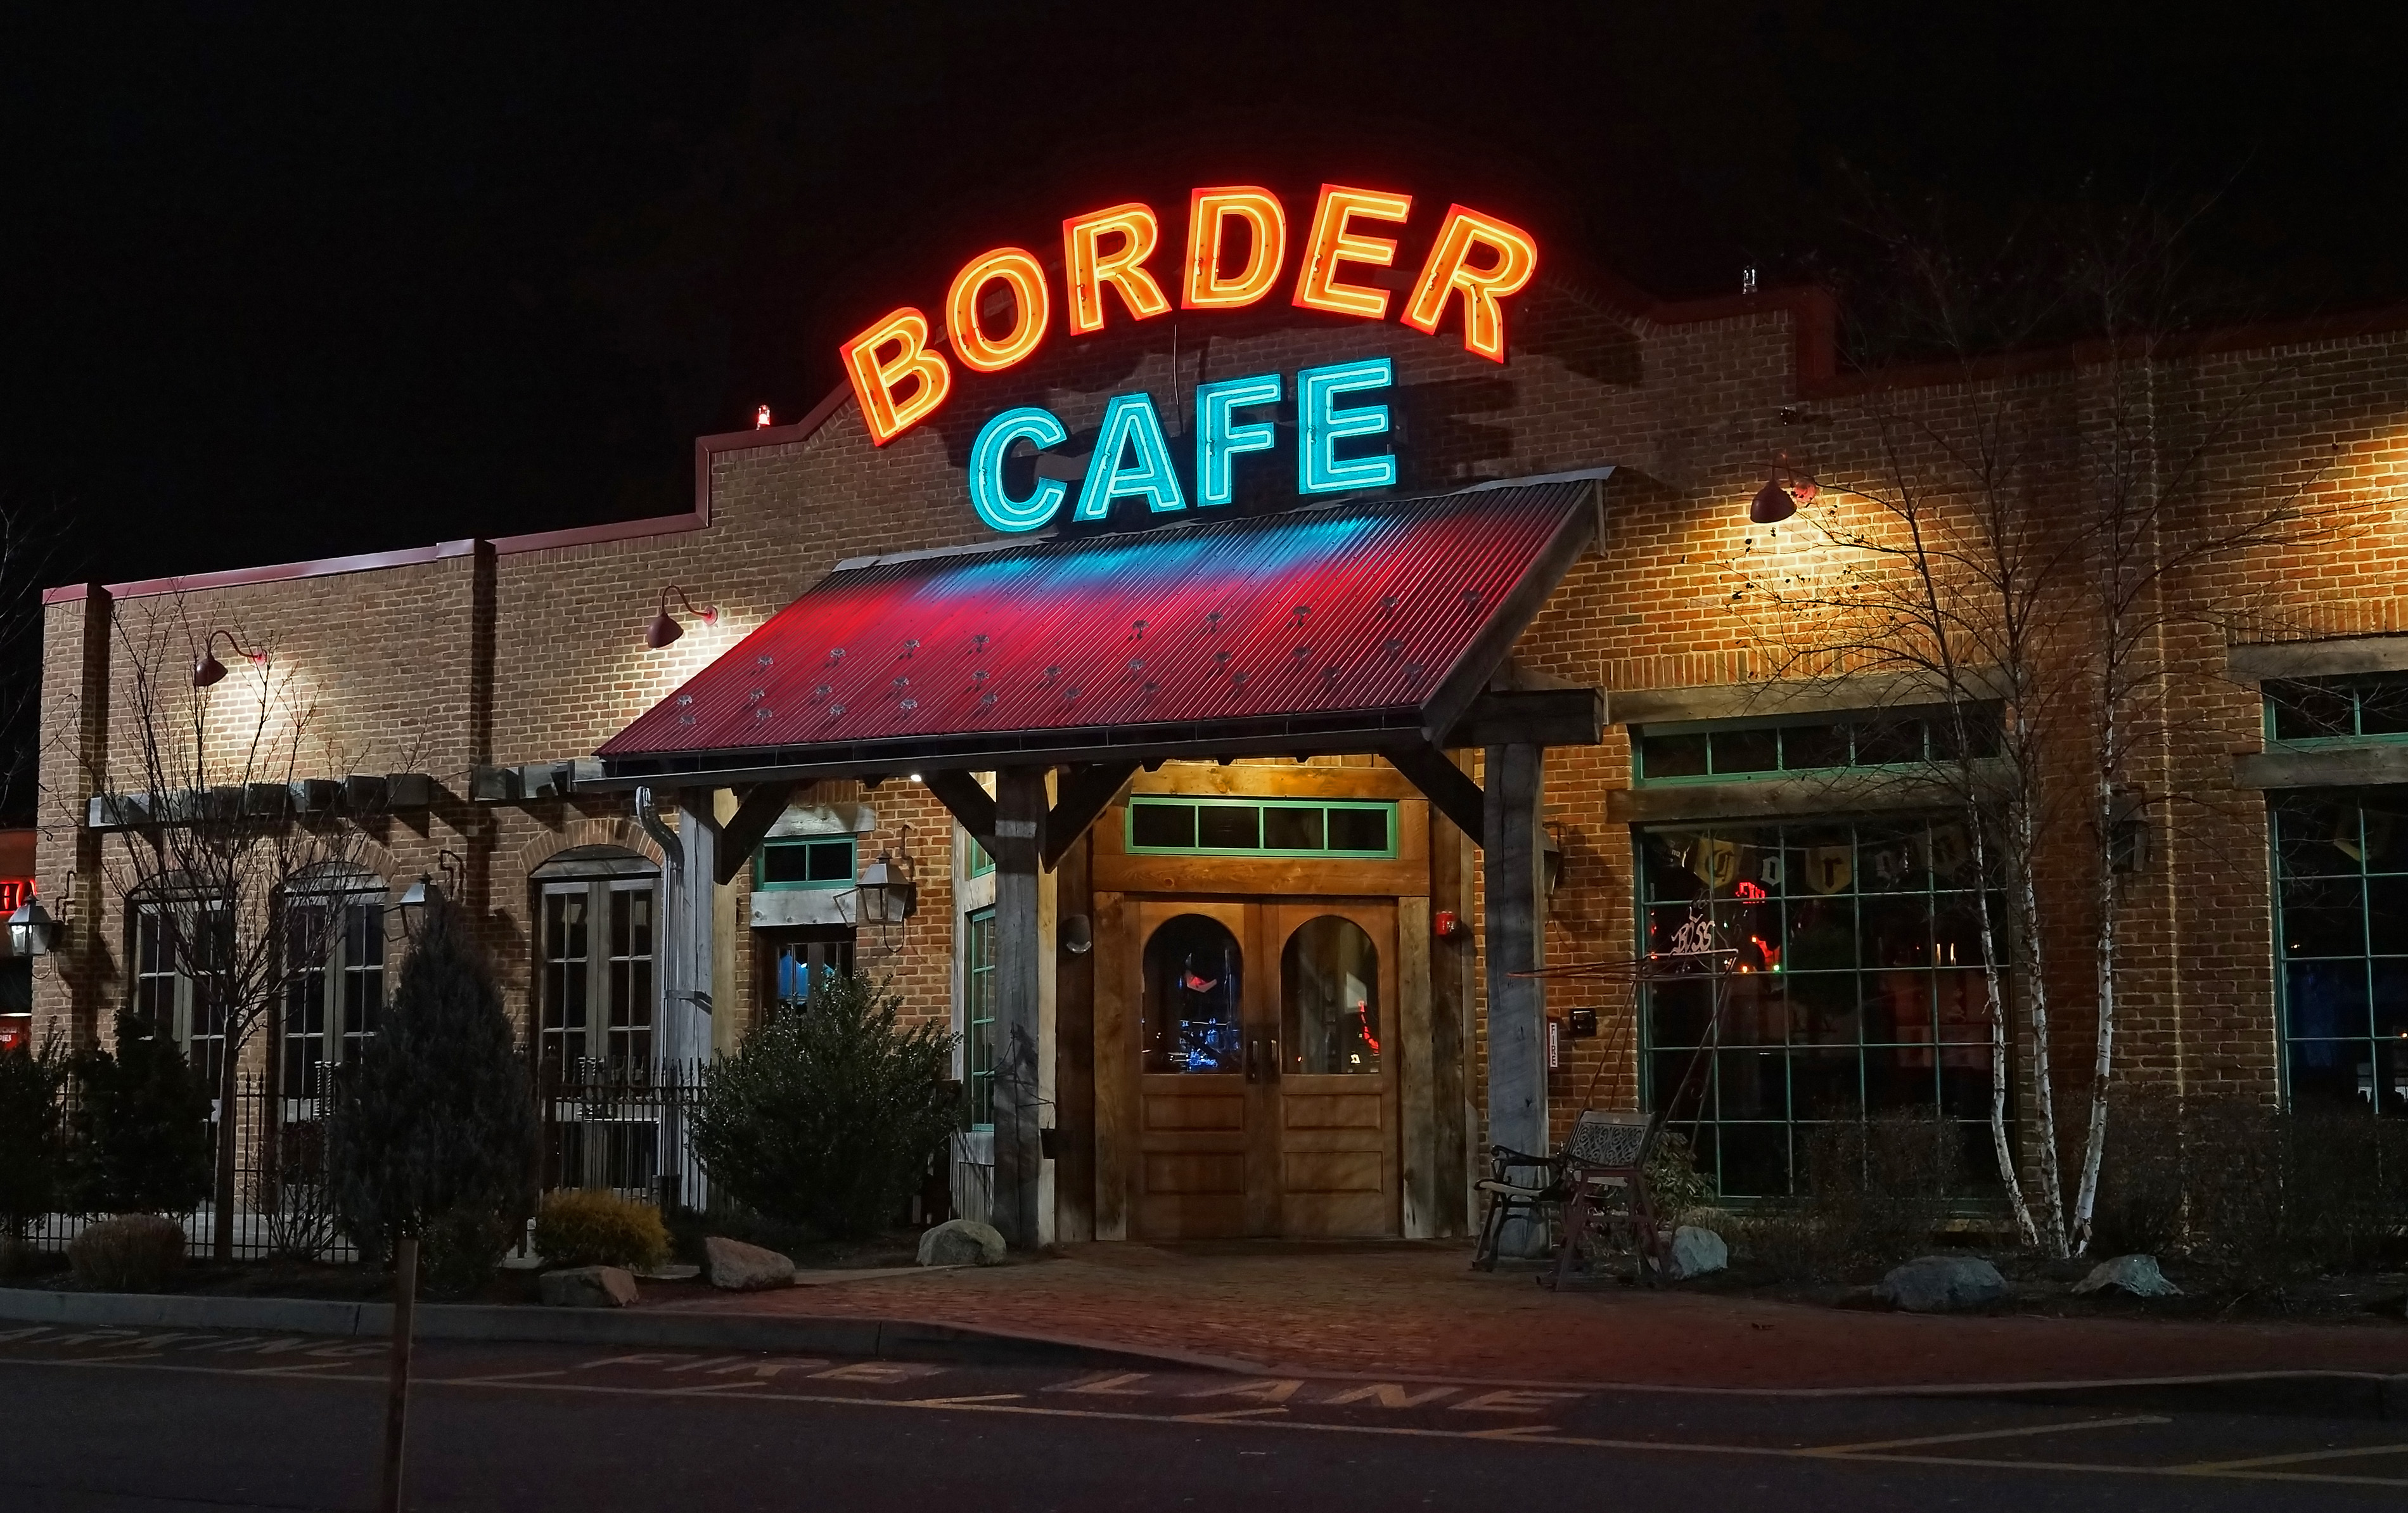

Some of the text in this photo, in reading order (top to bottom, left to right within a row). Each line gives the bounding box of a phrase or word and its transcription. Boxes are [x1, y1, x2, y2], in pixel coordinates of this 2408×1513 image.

[840, 183, 1537, 446] BORDER
[969, 357, 1396, 533] CAFE
[572, 1353, 954, 1384] FIRE
[1039, 1372, 1591, 1413] LANE
